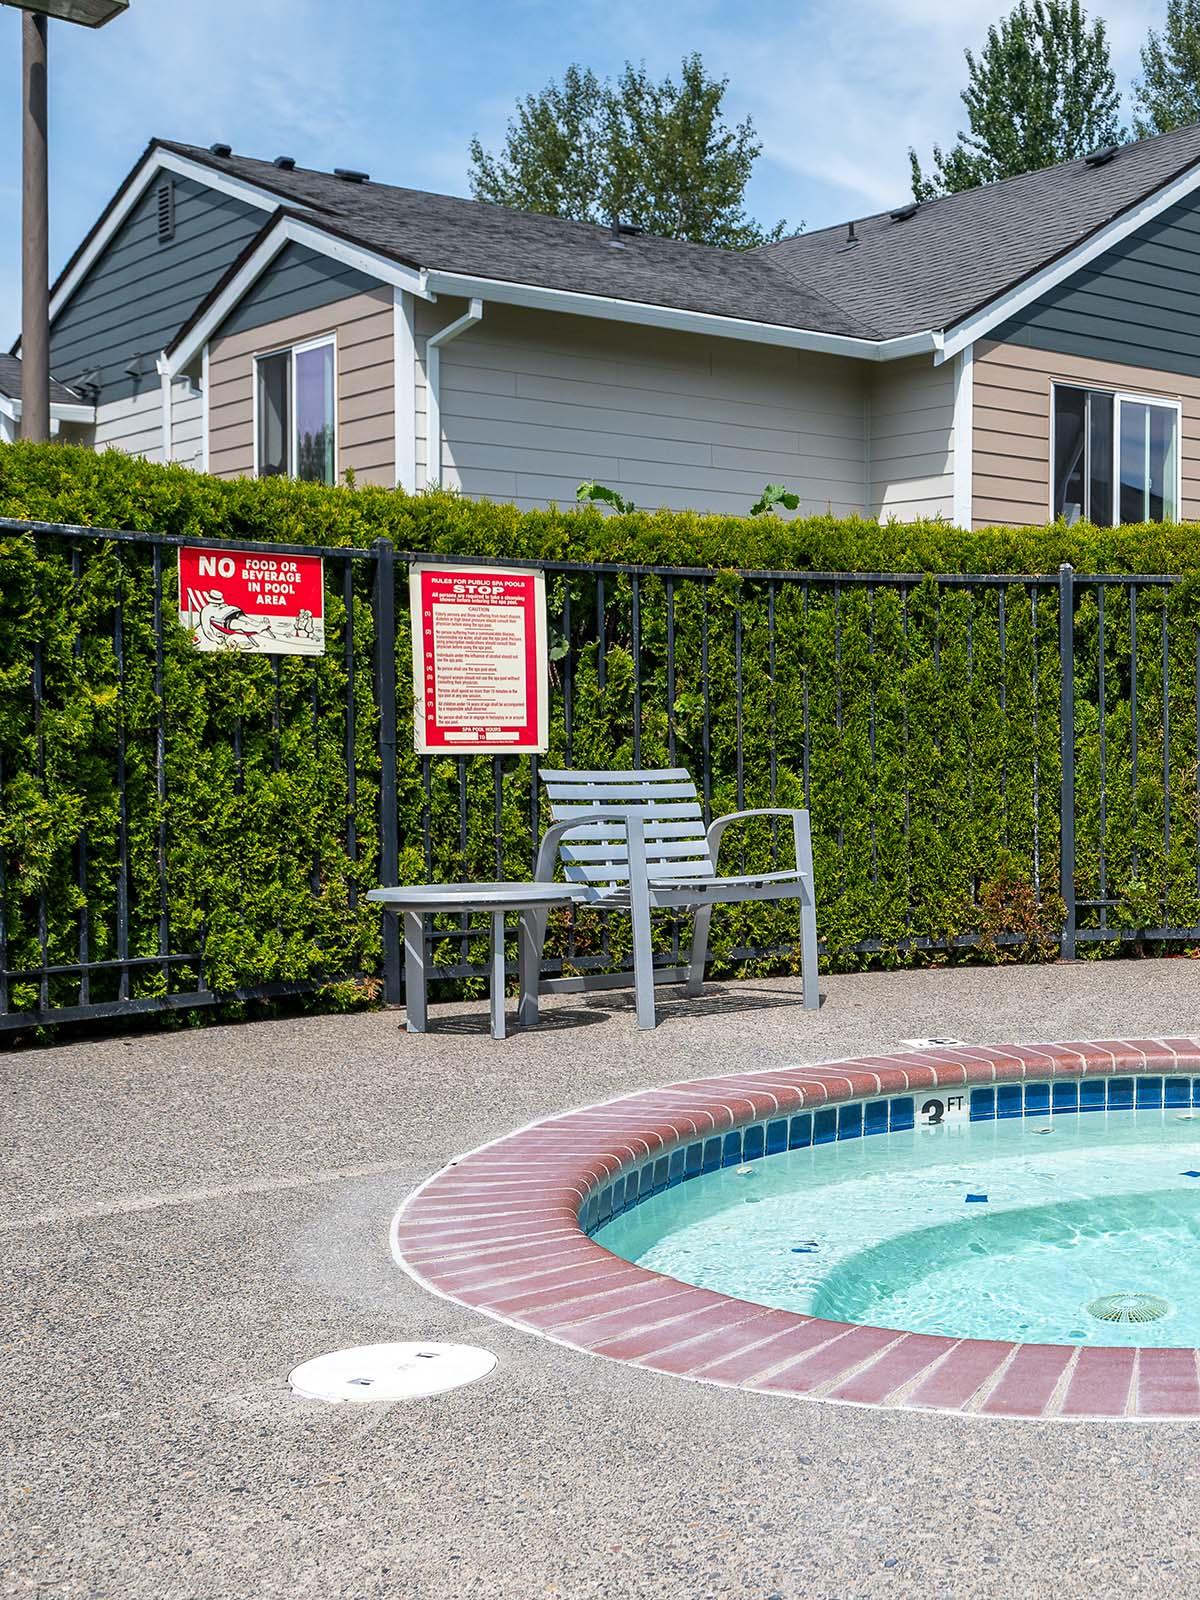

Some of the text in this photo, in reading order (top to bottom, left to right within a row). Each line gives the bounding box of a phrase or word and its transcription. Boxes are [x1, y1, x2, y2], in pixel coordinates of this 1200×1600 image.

[198, 556, 236, 578] NO
[246, 560, 297, 572] FOOD OR
[242, 569, 301, 583] BEVERAGE
[248, 582, 295, 594] IN POOL
[453, 585, 504, 595] STOP
[256, 595, 286, 605] AREA
[922, 1096, 964, 1125] 3 FT
